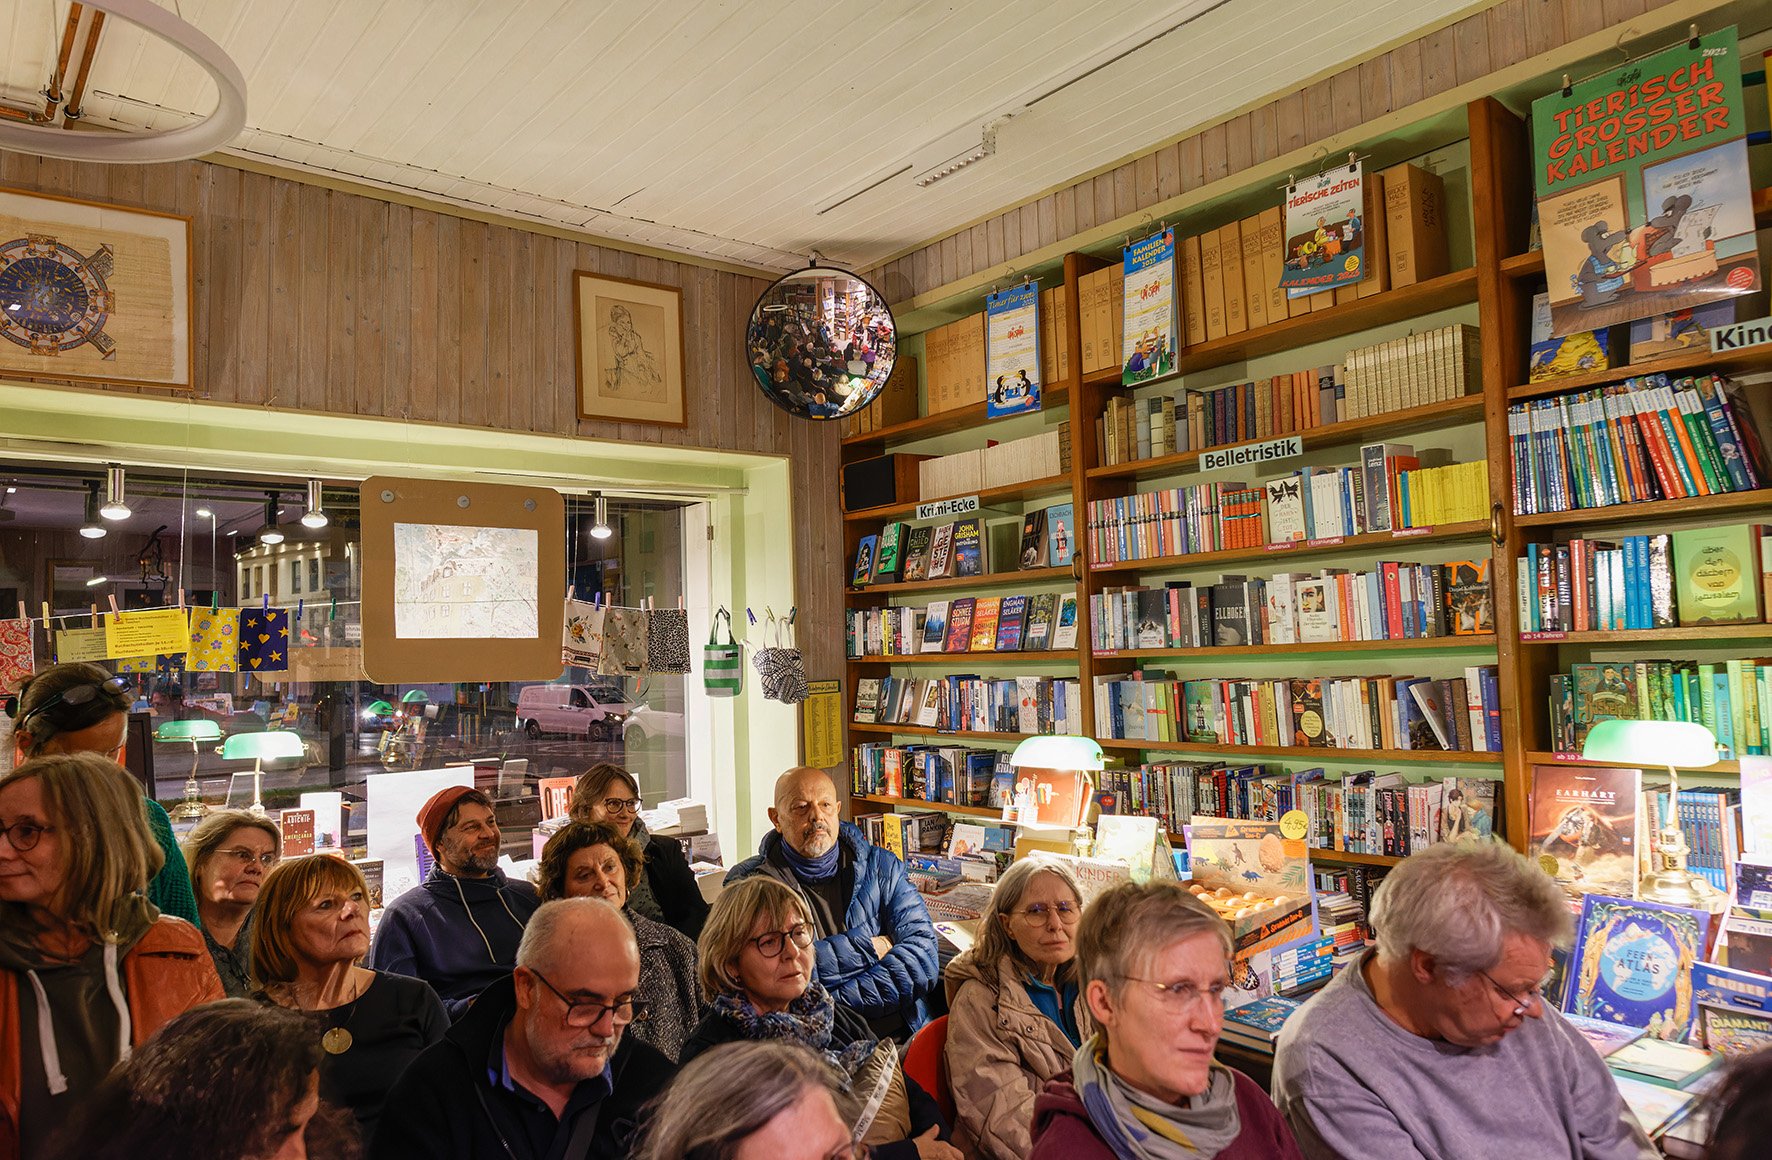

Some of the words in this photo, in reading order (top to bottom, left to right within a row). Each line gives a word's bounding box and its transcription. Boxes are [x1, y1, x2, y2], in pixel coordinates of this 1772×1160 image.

[1548, 81, 1725, 160] GROSSER
[1546, 106, 1730, 185] KALENDER
[1133, 238, 1164, 256] FAMILIEN
[1132, 246, 1166, 265] KALENDER
[1282, 274, 1334, 287] KALENDER
[1205, 440, 1298, 469] Belletristik
[920, 499, 976, 519] Krimi-Ecke
[954, 529, 979, 540] GRISHAM
[959, 523, 974, 533] JOHN
[1701, 545, 1724, 554] über
[1704, 557, 1723, 567] den
[1542, 631, 1564, 640] Jahren
[1555, 788, 1616, 799] EARHART
[924, 819, 935, 827] IAN
[1075, 867, 1120, 883] KINDER
[1626, 949, 1654, 962] FEEN
[1617, 959, 1660, 975] ATLAS
[1710, 1016, 1769, 1031] DIAMANT
